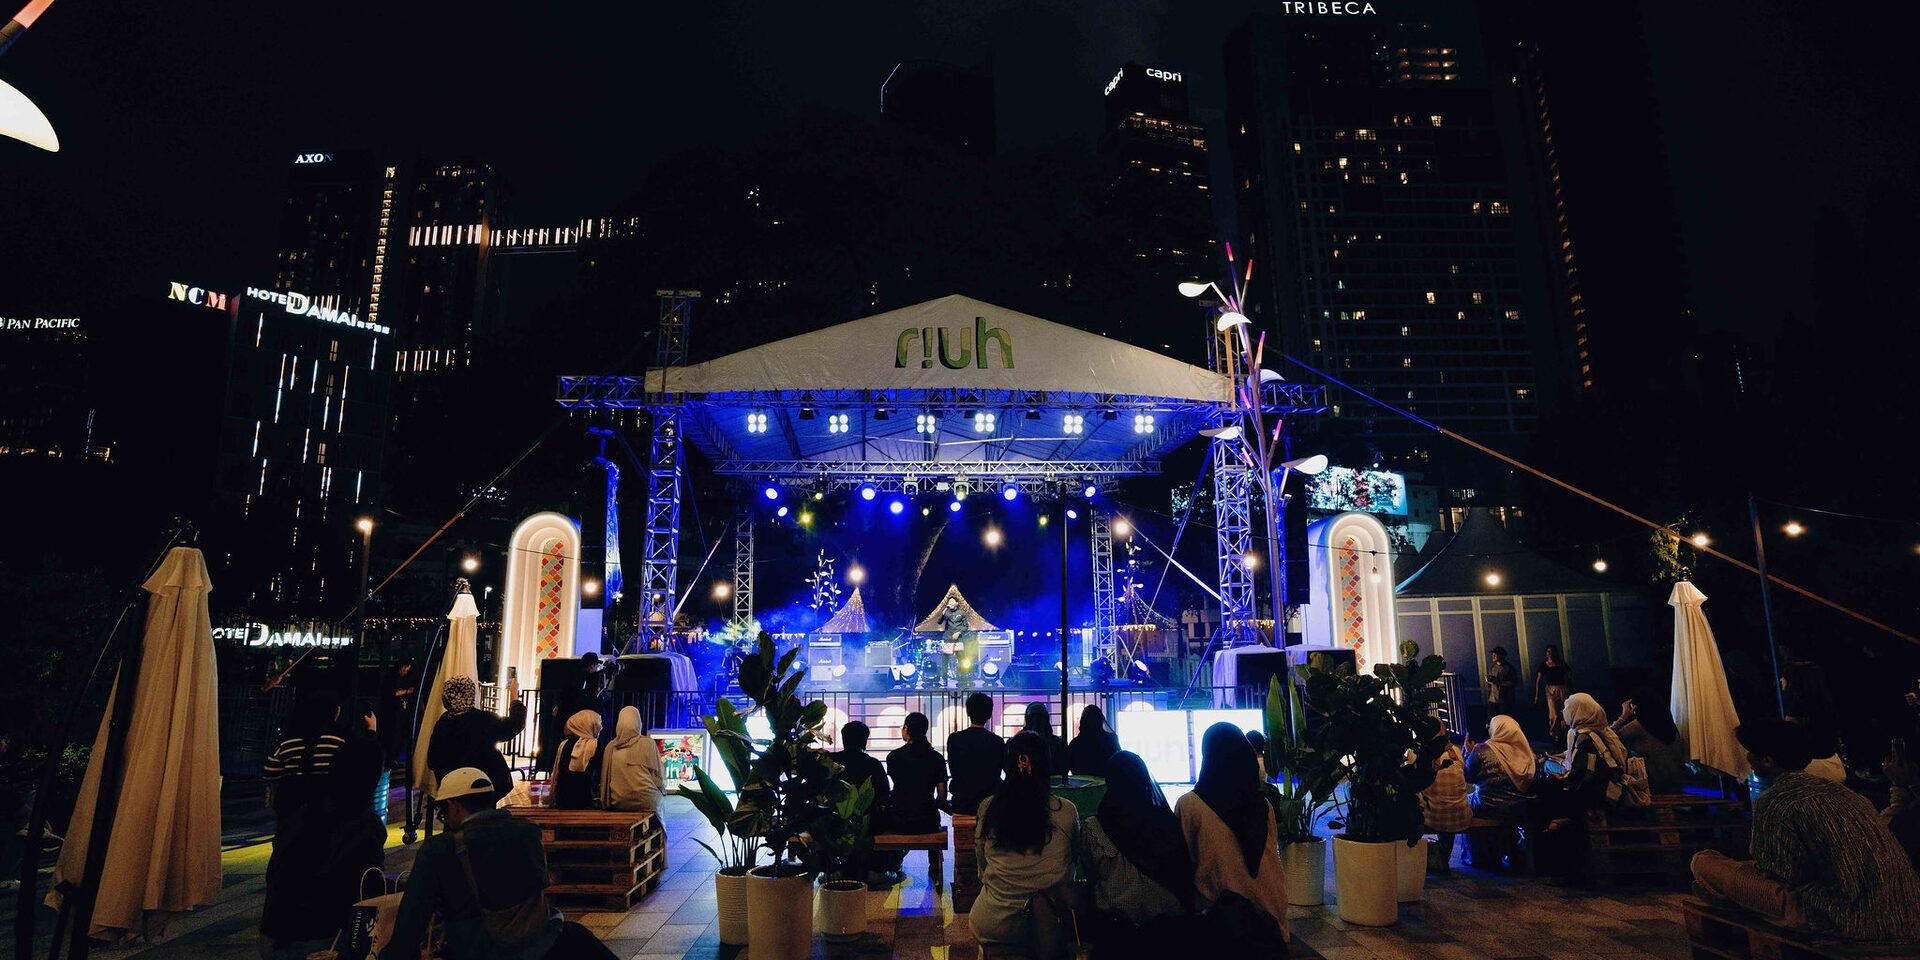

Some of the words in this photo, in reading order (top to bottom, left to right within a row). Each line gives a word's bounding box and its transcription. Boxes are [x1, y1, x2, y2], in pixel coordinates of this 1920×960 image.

[1282, 1, 1377, 15] TRIBECA
[1104, 67, 1124, 96] capri
[1146, 68, 1182, 82] capri
[294, 153, 334, 163] AXON
[168, 281, 227, 311] NCM
[286, 291, 357, 328] DAMAI
[7, 318, 31, 329] PAN
[34, 317, 81, 329] PACIFIC
